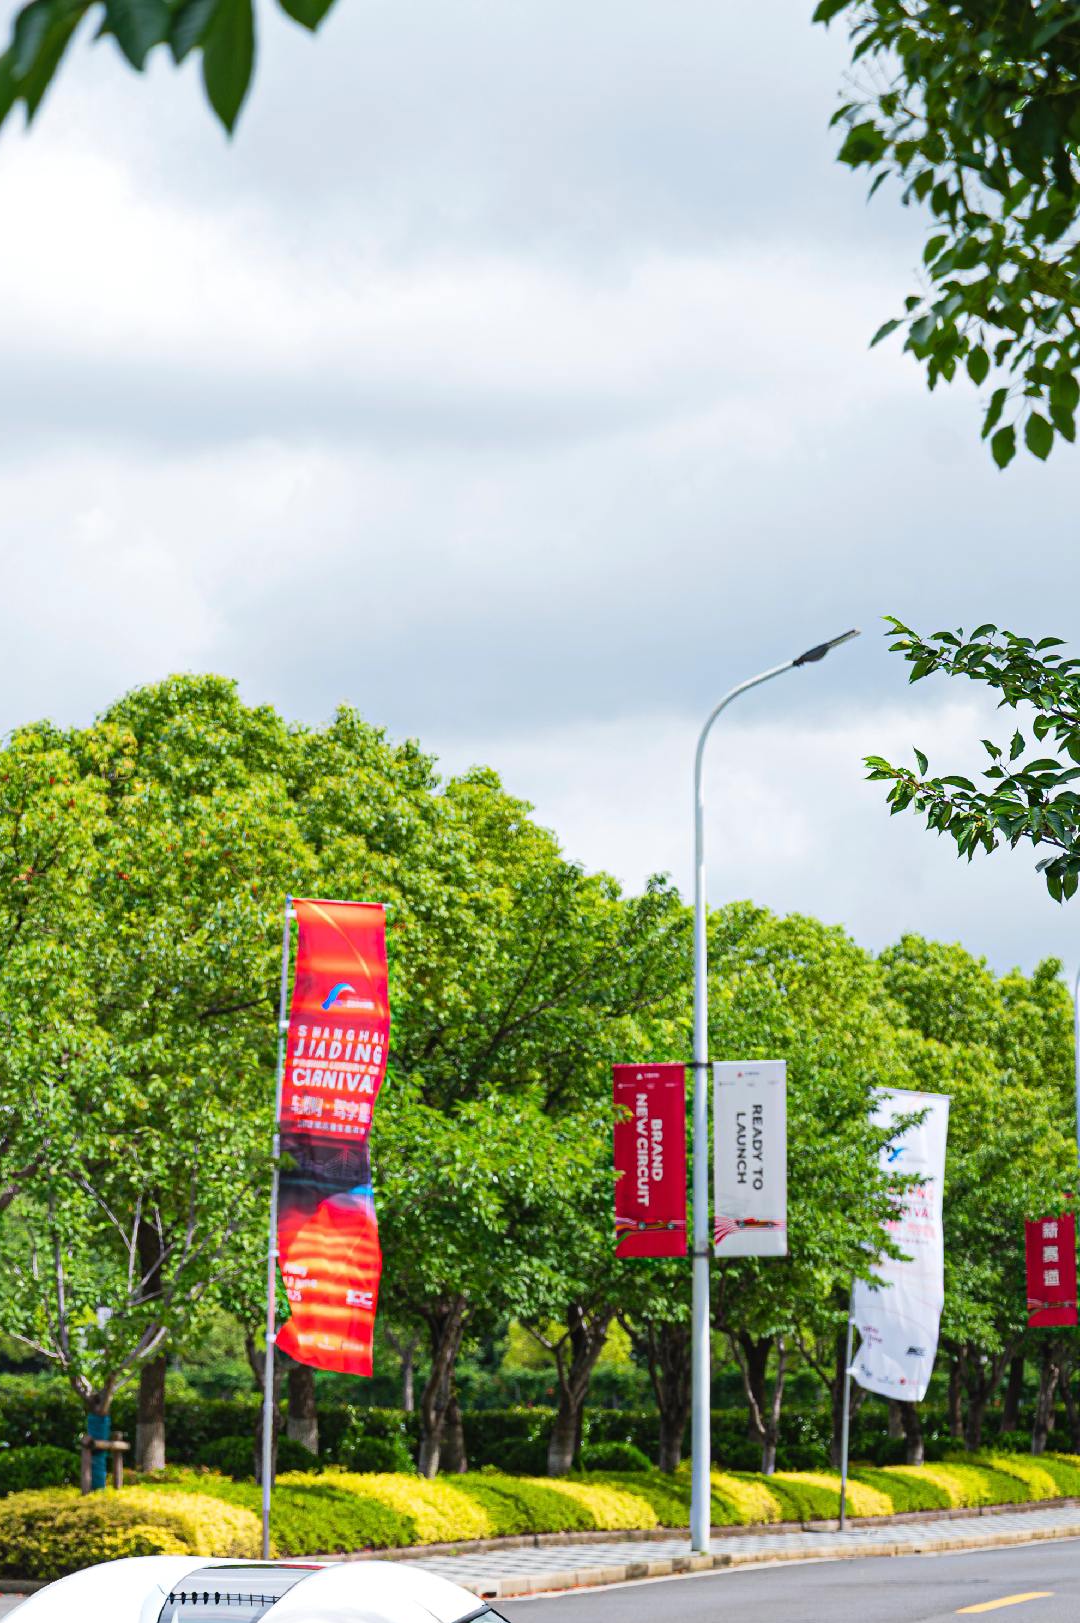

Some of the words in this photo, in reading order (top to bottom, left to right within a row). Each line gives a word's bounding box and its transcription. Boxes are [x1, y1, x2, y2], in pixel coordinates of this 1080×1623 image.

[294, 1038, 382, 1065] JIADING
[298, 1025, 384, 1045] SHANGHAI
[636, 1093, 648, 1135] NEW
[752, 1104, 763, 1162] READY
[636, 1136, 649, 1207] CIRCUIT
[652, 1119, 663, 1181] BRAND
[736, 1112, 747, 1185] LAUNCH
[753, 1168, 763, 1191] TO
